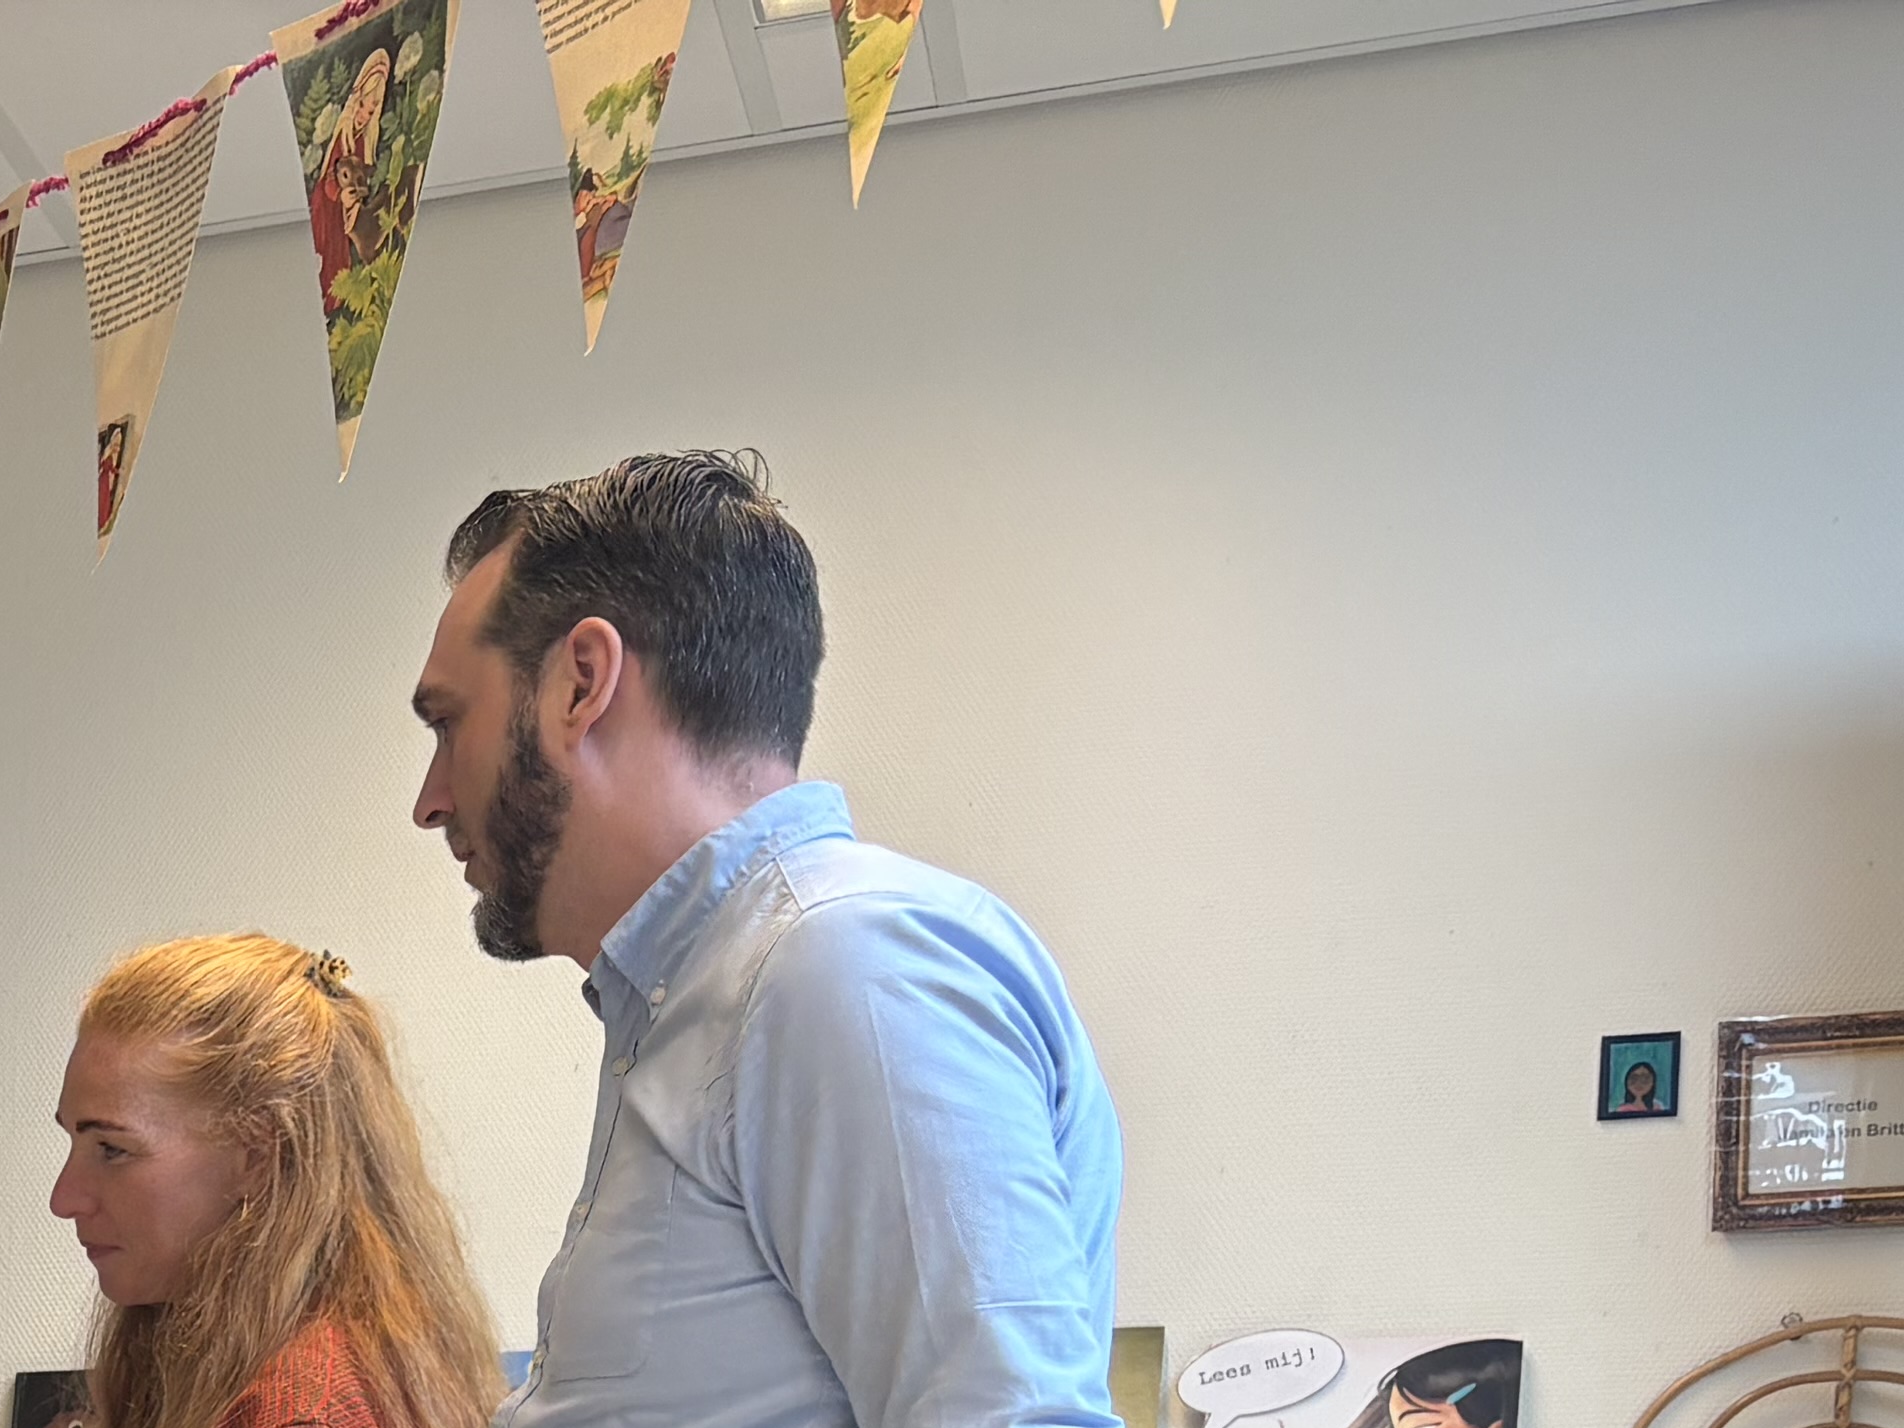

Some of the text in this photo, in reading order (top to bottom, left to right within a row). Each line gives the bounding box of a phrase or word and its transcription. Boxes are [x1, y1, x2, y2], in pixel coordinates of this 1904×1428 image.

[1808, 1099, 1878, 1113] Directie
[1198, 1346, 1316, 1386] Lees mij!
